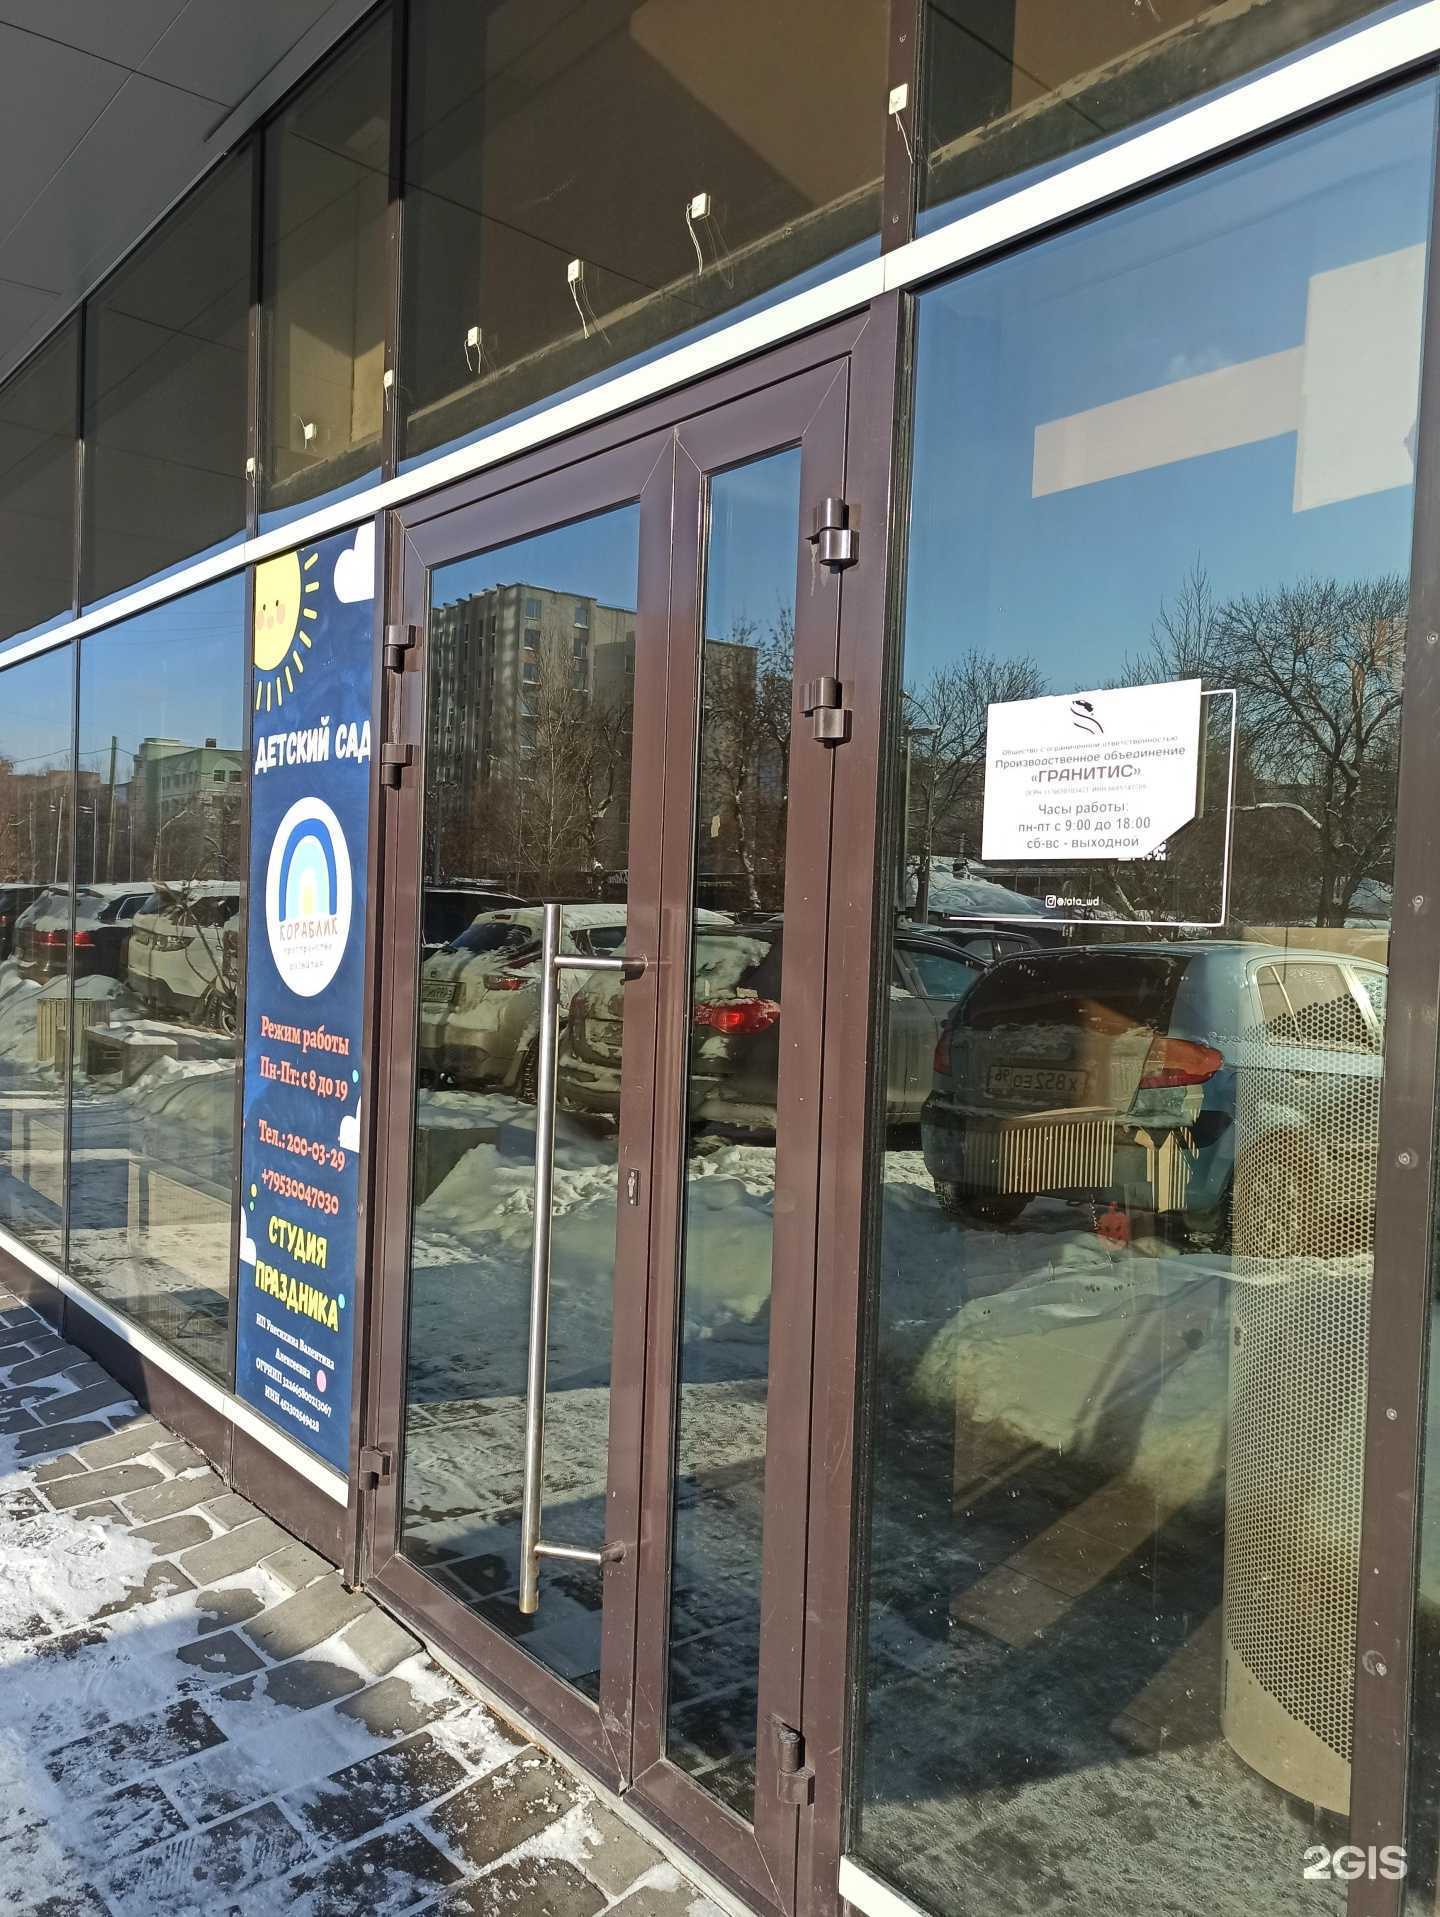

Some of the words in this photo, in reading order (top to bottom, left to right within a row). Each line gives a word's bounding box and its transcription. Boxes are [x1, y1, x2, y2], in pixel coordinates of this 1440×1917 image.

[255, 715, 329, 775] ДЕТСКИЙ
[335, 720, 371, 764] САД
[995, 752, 1100, 769] Производственное
[1104, 746, 1186, 762] объединение
[1031, 764, 1141, 783] «ГРАНИТИС»
[1018, 822, 1050, 833] пн-пт
[1054, 822, 1061, 832] с
[1065, 819, 1091, 832] 9:00
[1094, 820, 1112, 833] до
[1117, 816, 1151, 830] 18:00
[1038, 802, 1071, 815] Часы
[1075, 801, 1129, 816] работы:
[1026, 837, 1060, 849] сб-вс
[1071, 836, 1140, 849] выходной
[279, 917, 338, 942] КОРАБЛИК
[260, 1015, 301, 1045] Режим
[302, 1024, 350, 1056] работы
[259, 1055, 300, 1087] Пн-Пт:
[301, 1073, 308, 1089] с
[309, 1070, 316, 1091] 8
[317, 1077, 333, 1098] до
[335, 1079, 349, 1102] 19
[258, 1118, 285, 1147] Тел.:
[286, 1133, 346, 1173] 200-03-29
[261, 1168, 339, 1216] +79530047030
[268, 1215, 327, 1269] СТУДИЯ
[255, 1260, 339, 1332] ПРАЗДНИКА
